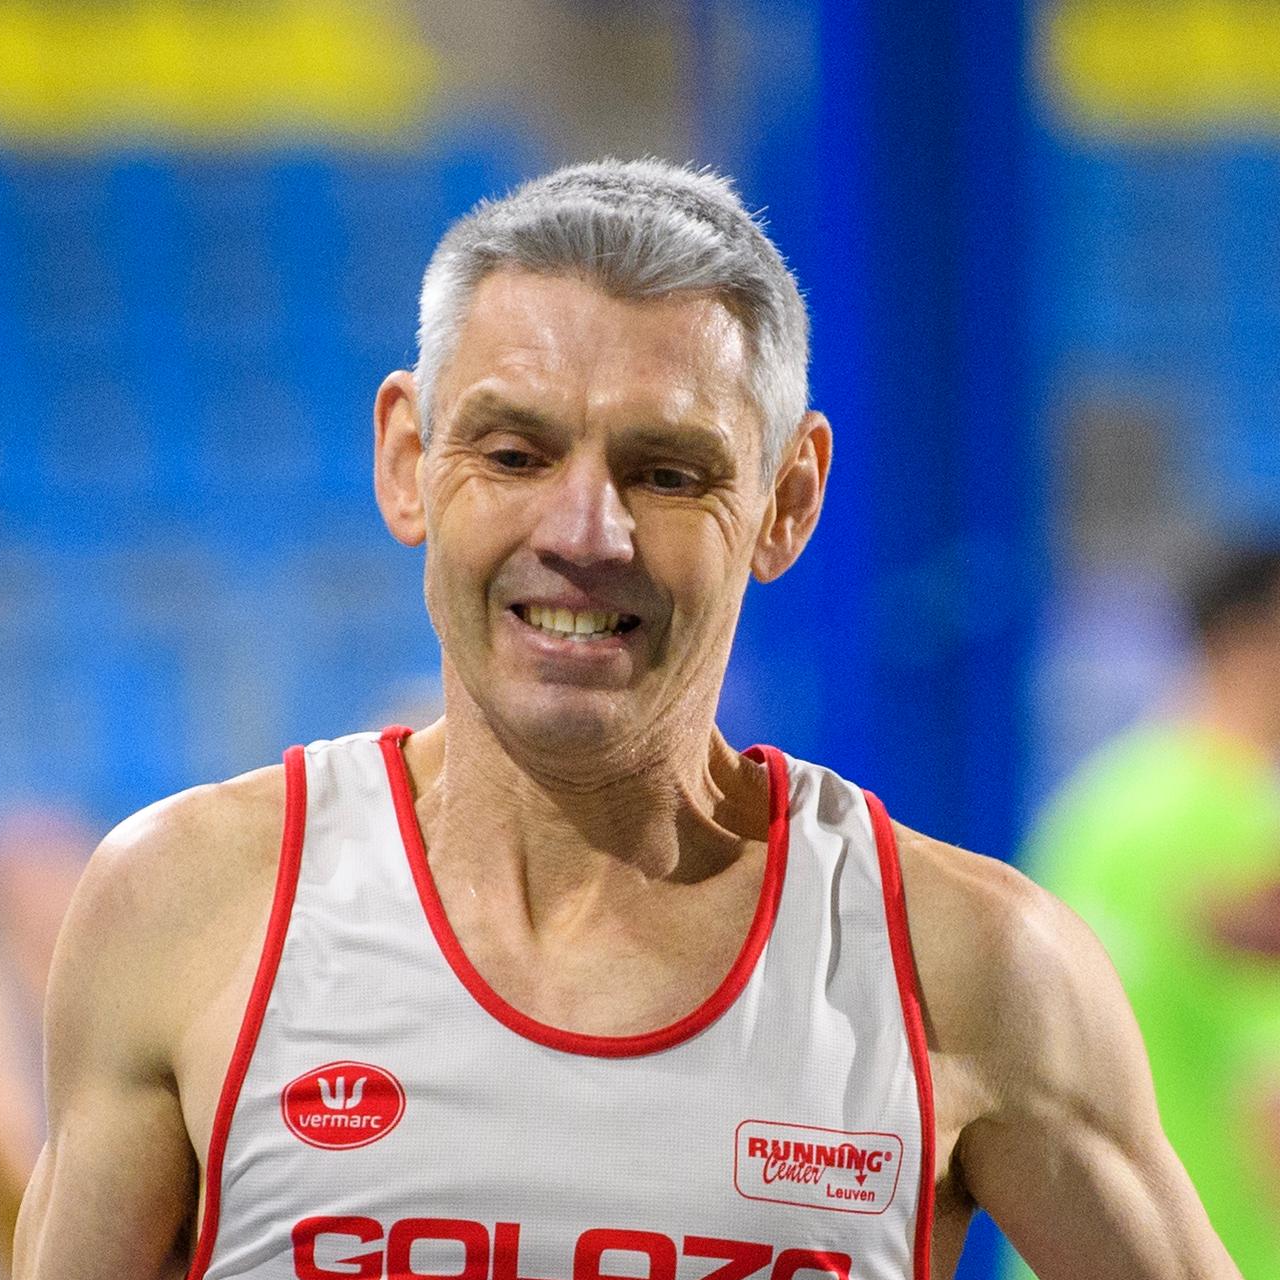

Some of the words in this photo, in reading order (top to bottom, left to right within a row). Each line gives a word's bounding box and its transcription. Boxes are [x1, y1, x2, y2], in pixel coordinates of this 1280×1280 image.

[299, 1112, 381, 1128] vermarc
[763, 1152, 825, 1185] Center
[826, 1184, 876, 1202] Leuven
